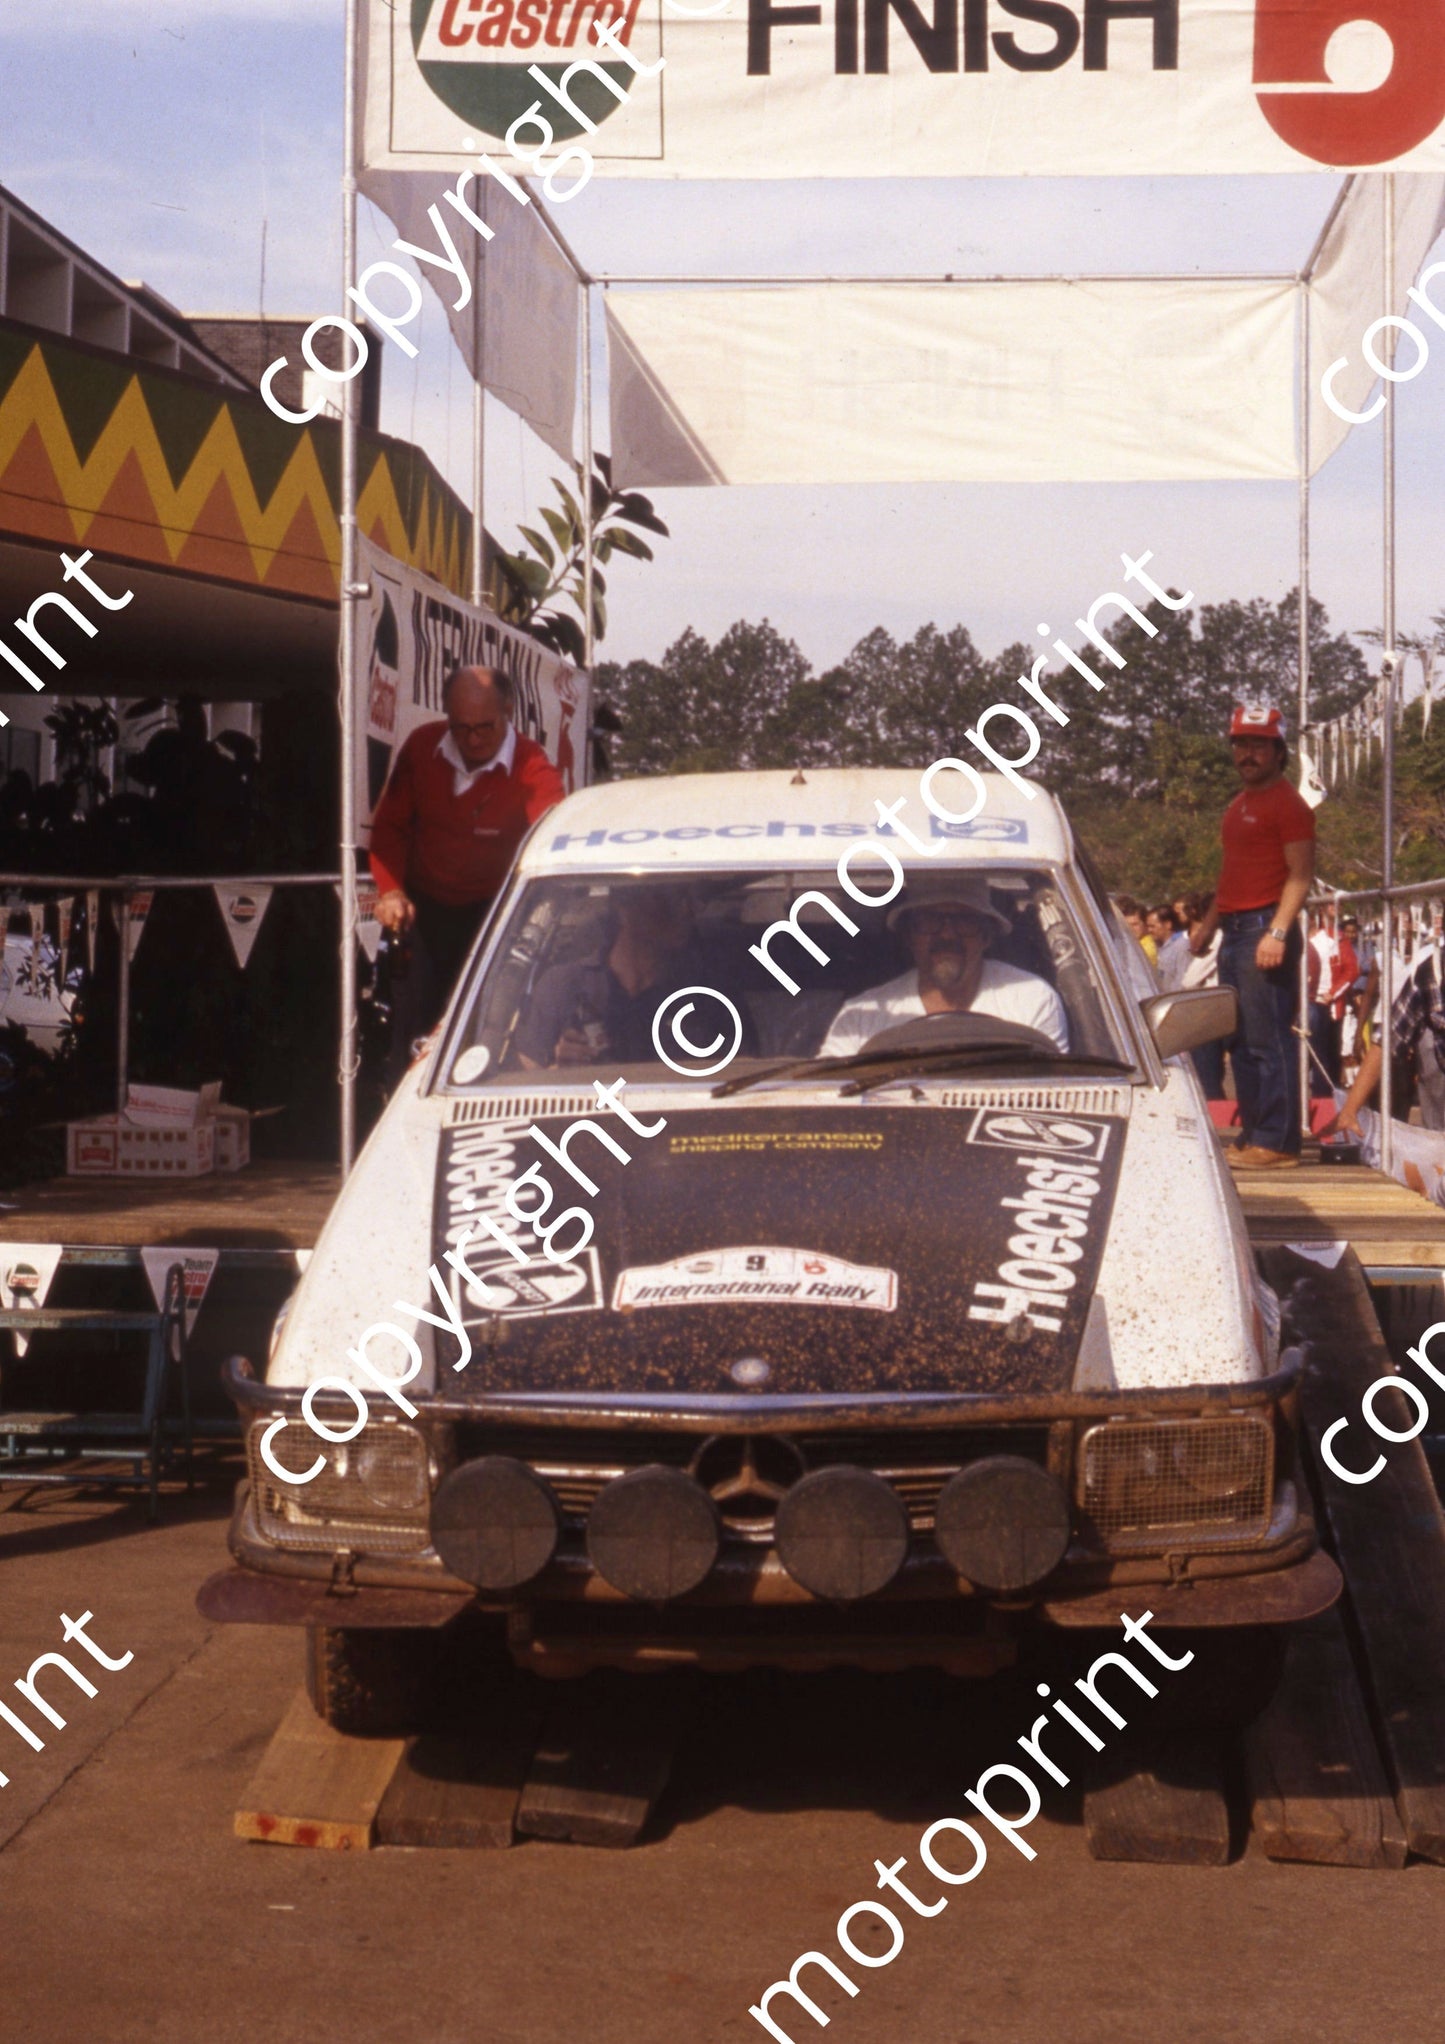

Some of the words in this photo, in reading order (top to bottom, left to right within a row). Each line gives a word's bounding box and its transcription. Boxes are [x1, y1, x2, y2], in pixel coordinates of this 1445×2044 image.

[747, 0, 1178, 76] FINISH
[670, 1132, 884, 1145] mediterranean
[967, 1156, 1101, 1333] Hoechst
[745, 1255, 766, 1272] 9
[634, 1280, 802, 1300] International
[806, 1281, 877, 1301] Rally
